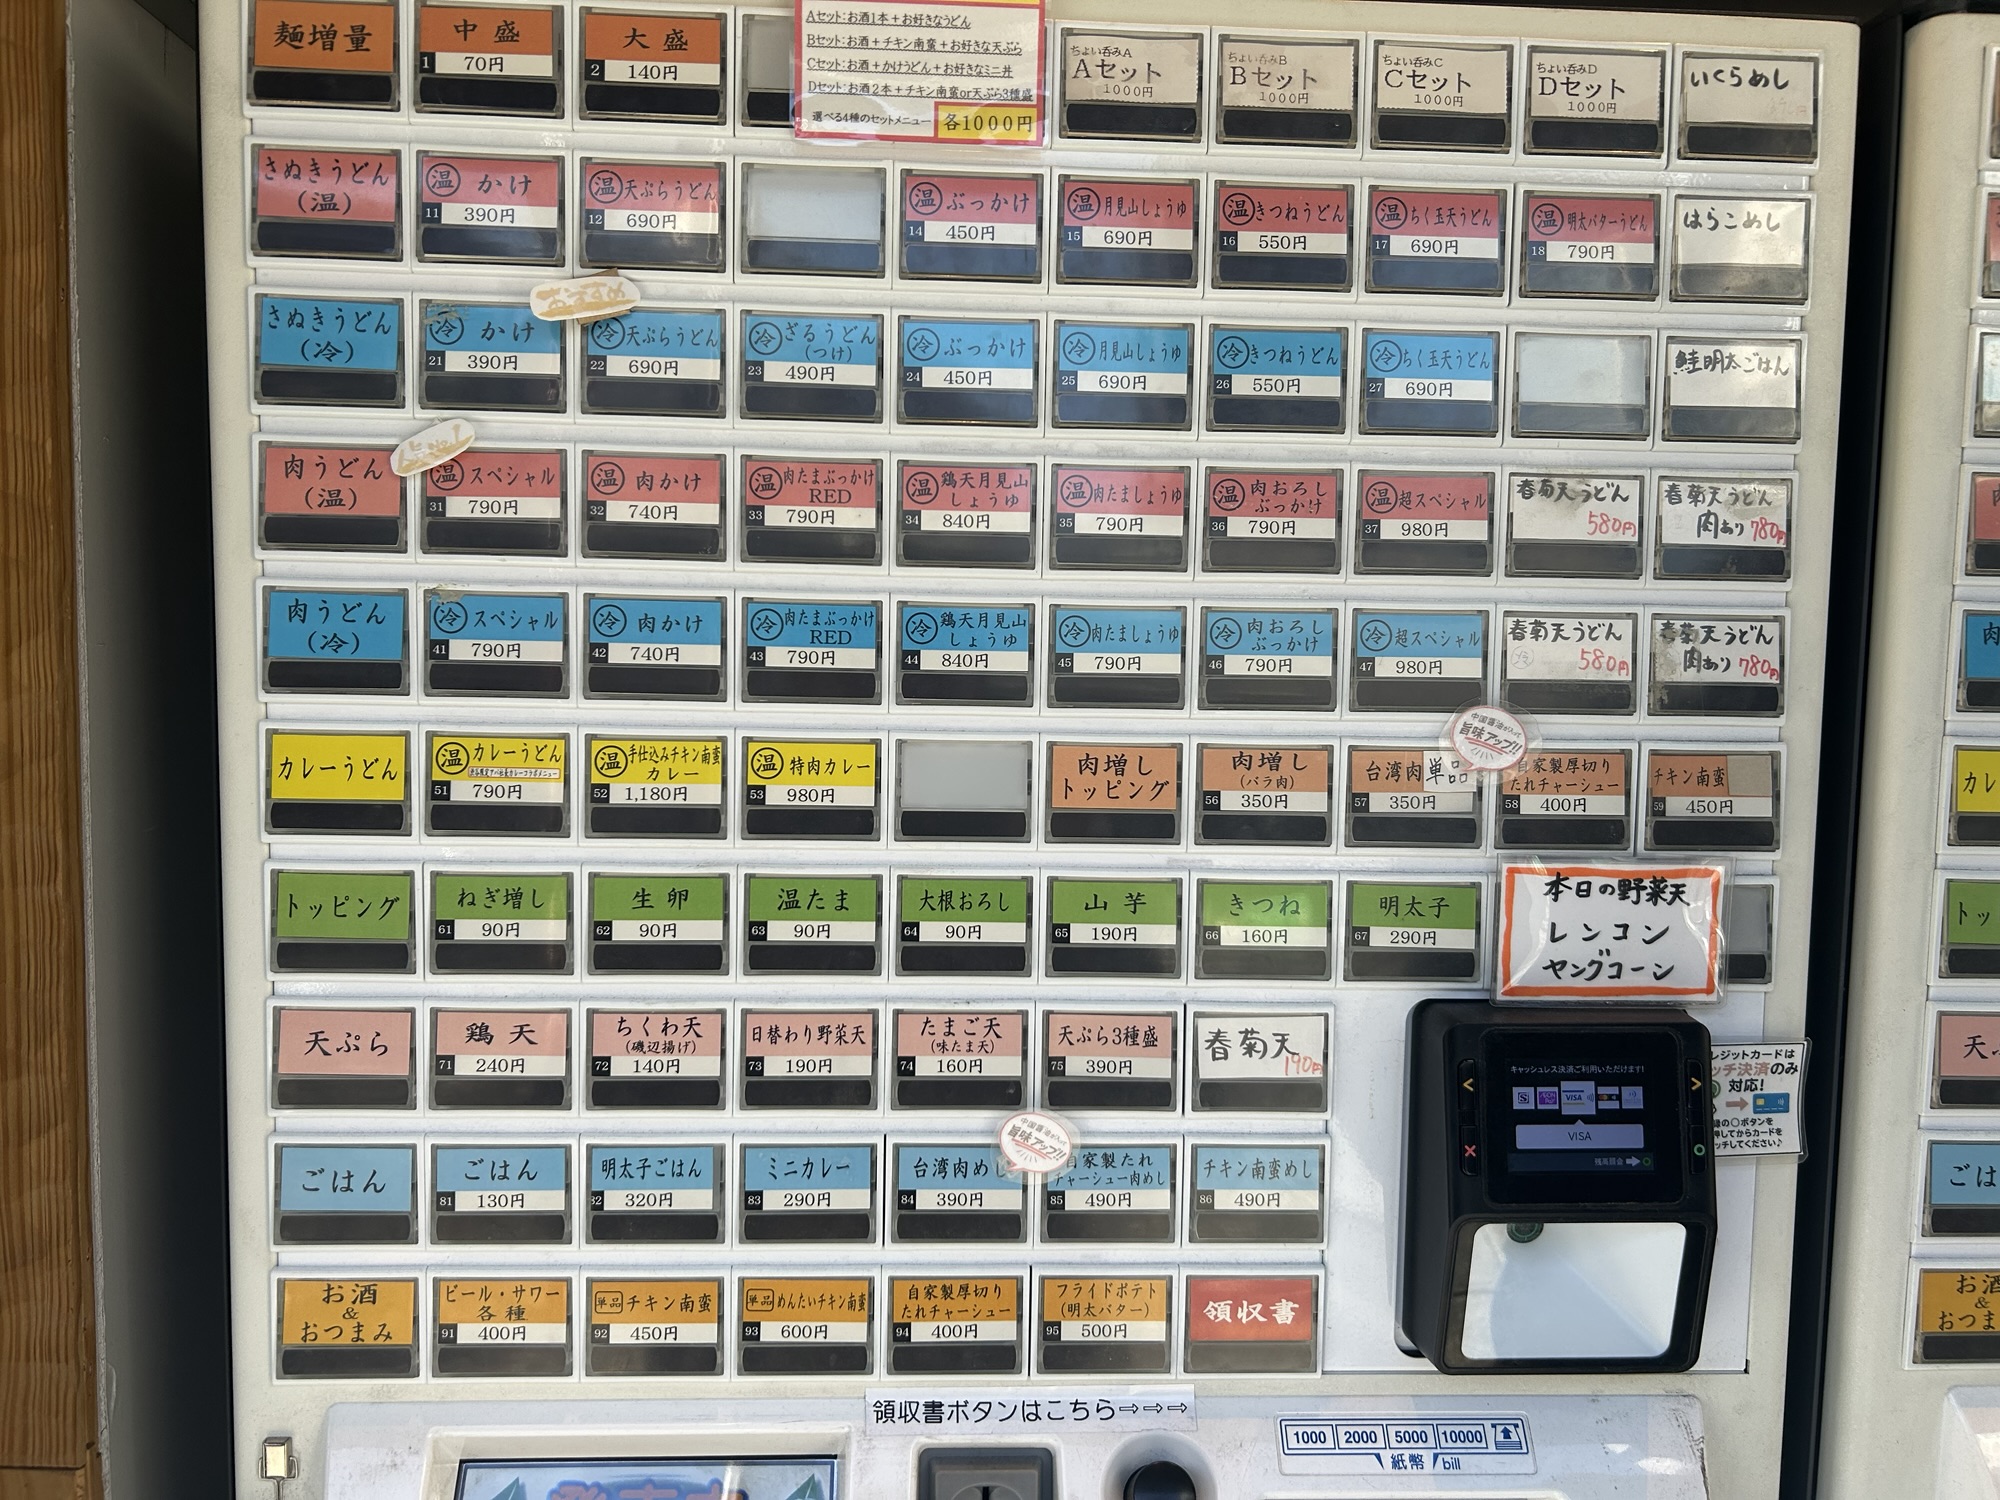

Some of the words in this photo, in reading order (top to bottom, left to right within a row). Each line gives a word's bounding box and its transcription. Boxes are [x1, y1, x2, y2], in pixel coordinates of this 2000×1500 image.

[274, 21, 372, 52] 麺増量
[464, 57, 503, 72] 70円
[629, 65, 677, 81] 140円
[1072, 59, 1161, 83] Aセット
[1230, 66, 1317, 90] Bセット
[1385, 70, 1471, 93] Cセット
[1104, 84, 1152, 97] 1000円
[1539, 77, 1624, 100] Dセット
[1415, 94, 1463, 107] 1000円
[944, 114, 1032, 132] 各1000円
[265, 156, 387, 185] さぬきうどん
[298, 191, 351, 215] (温)
[1259, 235, 1306, 250] 550円
[269, 305, 391, 334] さぬきうどん
[301, 339, 353, 363] (冷)
[629, 360, 678, 376] 690円
[1253, 378, 1300, 393] 550円
[1406, 382, 1452, 397] 690円
[285, 454, 383, 480] 肉うどん
[305, 487, 356, 510] (温)
[809, 488, 851, 504] RED
[629, 505, 677, 520] 740円
[943, 514, 989, 529] 840円
[1402, 522, 1448, 537] 980円
[289, 598, 385, 624] 肉うどん
[308, 631, 359, 654] (冷)
[810, 630, 851, 644] RED
[631, 647, 679, 662] 740円
[942, 654, 988, 668] 840円
[1245, 658, 1291, 673] 790円
[279, 756, 397, 781] カレーうどん
[1079, 753, 1152, 777] 肉増し
[1232, 751, 1307, 771] 肉増し
[1241, 775, 1294, 789] (バラ肉)
[1511, 777, 1618, 793] たれチャーシュー
[1654, 767, 1724, 787] チキン南蛮
[473, 784, 521, 799] 790円
[626, 787, 687, 802] 1,180円
[787, 789, 834, 803] 980円
[1065, 778, 1169, 801] トッピング
[1242, 794, 1287, 809] 350円
[1390, 795, 1435, 810] 350円
[1686, 800, 1733, 814] 450円
[1544, 871, 1691, 906] 本日の野菜天
[458, 887, 544, 909] ねぎ増し
[778, 888, 849, 911] 温たま
[920, 890, 1009, 911] 大根おろし
[1230, 894, 1300, 916] きつね
[289, 894, 399, 920] トッピング
[1380, 896, 1449, 918] 明太子
[640, 923, 676, 938] 90円
[946, 925, 981, 939] 90円
[1092, 927, 1136, 941] 190円
[1243, 929, 1287, 944] 160円
[1390, 931, 1436, 945] 290円
[618, 1016, 703, 1038] ちくわ天
[753, 1024, 865, 1045] 日替わり野菜天
[921, 1017, 1002, 1038] たまご天
[305, 1031, 388, 1056] 天ぷら
[1059, 1025, 1158, 1048] 天ぷら3種盛
[626, 1040, 696, 1054] (磯辺揚げ)
[931, 1039, 994, 1054] (味たま天)
[476, 1058, 524, 1073] 240円
[634, 1059, 679, 1073] 140円
[787, 1059, 831, 1073] 190円
[938, 1059, 982, 1073] 160円
[1086, 1060, 1131, 1075] 390円
[1729, 1078, 1764, 1092] 対応!
[1568, 1132, 1591, 1140] VISA
[465, 1158, 537, 1181] ごはん
[602, 1157, 701, 1180] 明太子ごはん
[769, 1157, 849, 1180] ミニカレー
[914, 1157, 1004, 1179] 台湾肉めし
[1204, 1158, 1311, 1180] チキン南蛮めし
[303, 1168, 385, 1193] ごはん
[1056, 1170, 1164, 1186] チャーシュー肉めし
[322, 1283, 377, 1305] お酒
[447, 1284, 559, 1303] ビール・サワー
[909, 1283, 1001, 1300] 自家製厚切り
[1057, 1282, 1155, 1300] フライドポテト
[343, 1307, 359, 1319] &
[477, 1305, 525, 1321] 各種
[902, 1304, 1010, 1319] たれチャーシュー
[1061, 1302, 1148, 1318] (明太バター)
[1203, 1299, 1299, 1324] 領収書
[300, 1321, 393, 1342] おつまみ
[873, 1399, 1115, 1423] 領収書ボタンはこちら
[1294, 1431, 1326, 1444] 1000
[1344, 1431, 1377, 1443] 2000
[1395, 1430, 1428, 1443] 5000
[1442, 1430, 1482, 1443] 10000
[1391, 1453, 1424, 1470] 紙幣
[1442, 1457, 1460, 1470] bill
